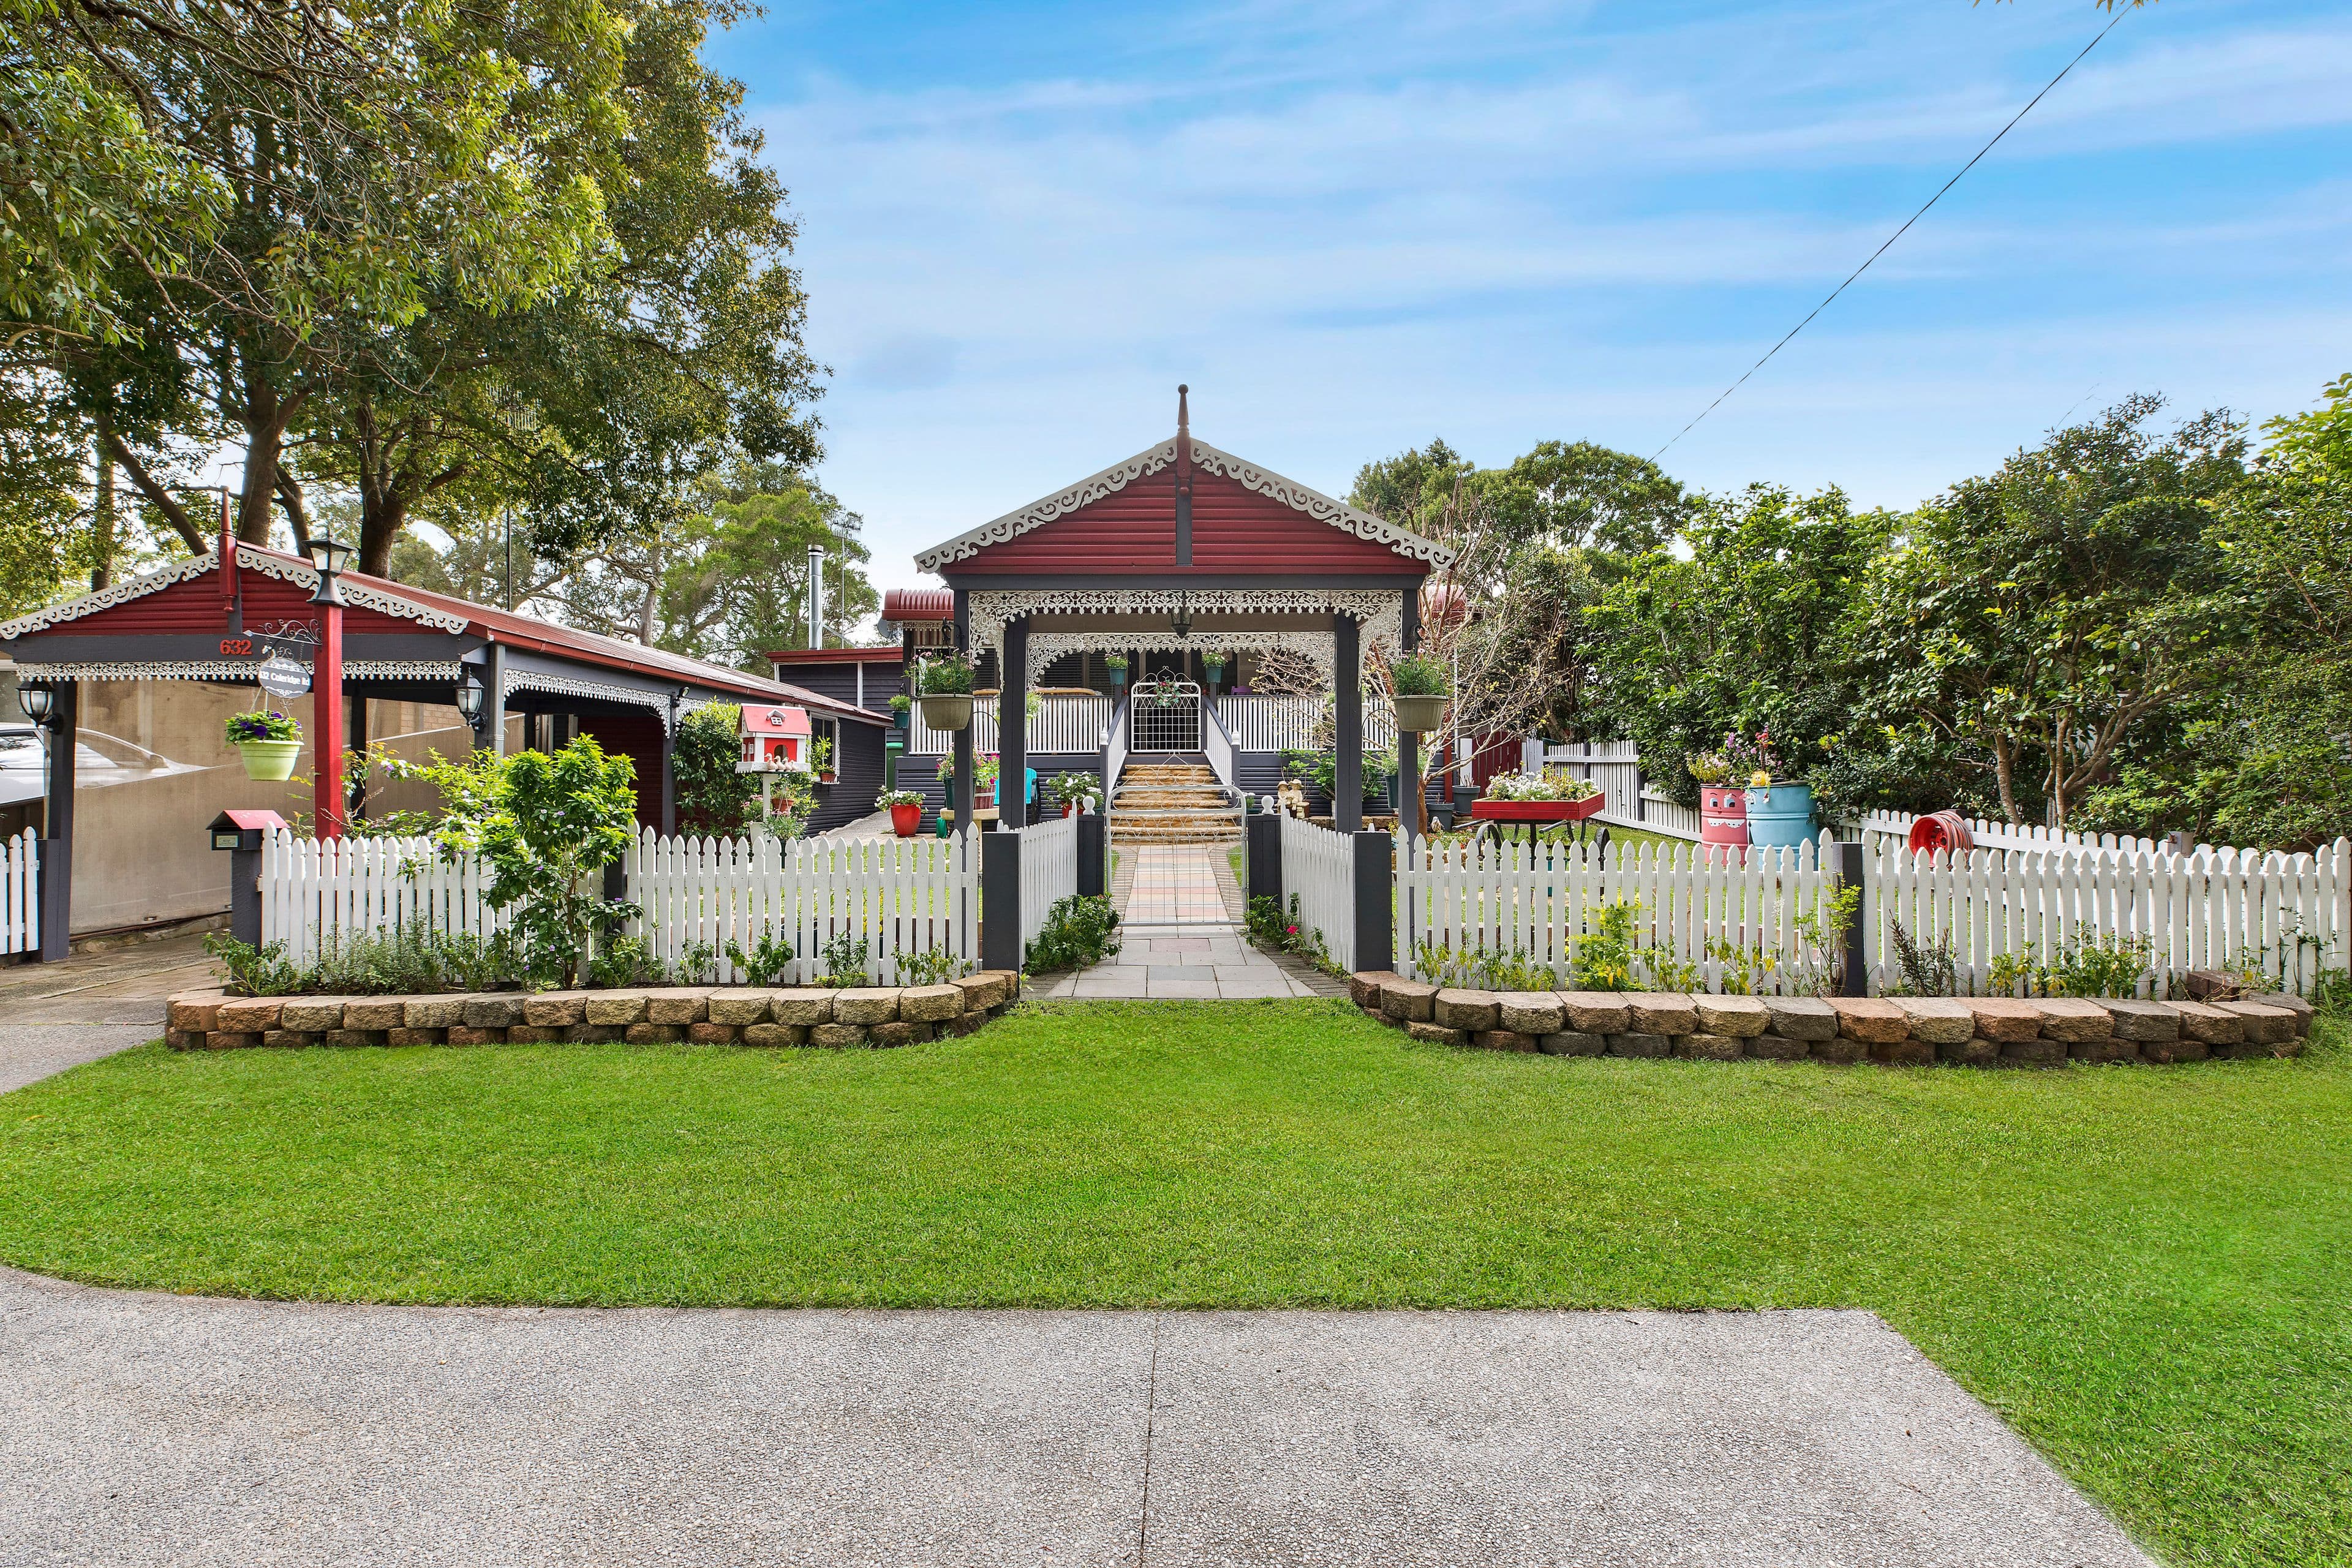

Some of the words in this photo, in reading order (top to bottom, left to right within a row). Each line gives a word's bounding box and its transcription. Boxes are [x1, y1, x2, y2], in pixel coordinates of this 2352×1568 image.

[220, 639, 252, 655] 632
[270, 673, 301, 685] Coleridge
[301, 677, 311, 686] Rd
